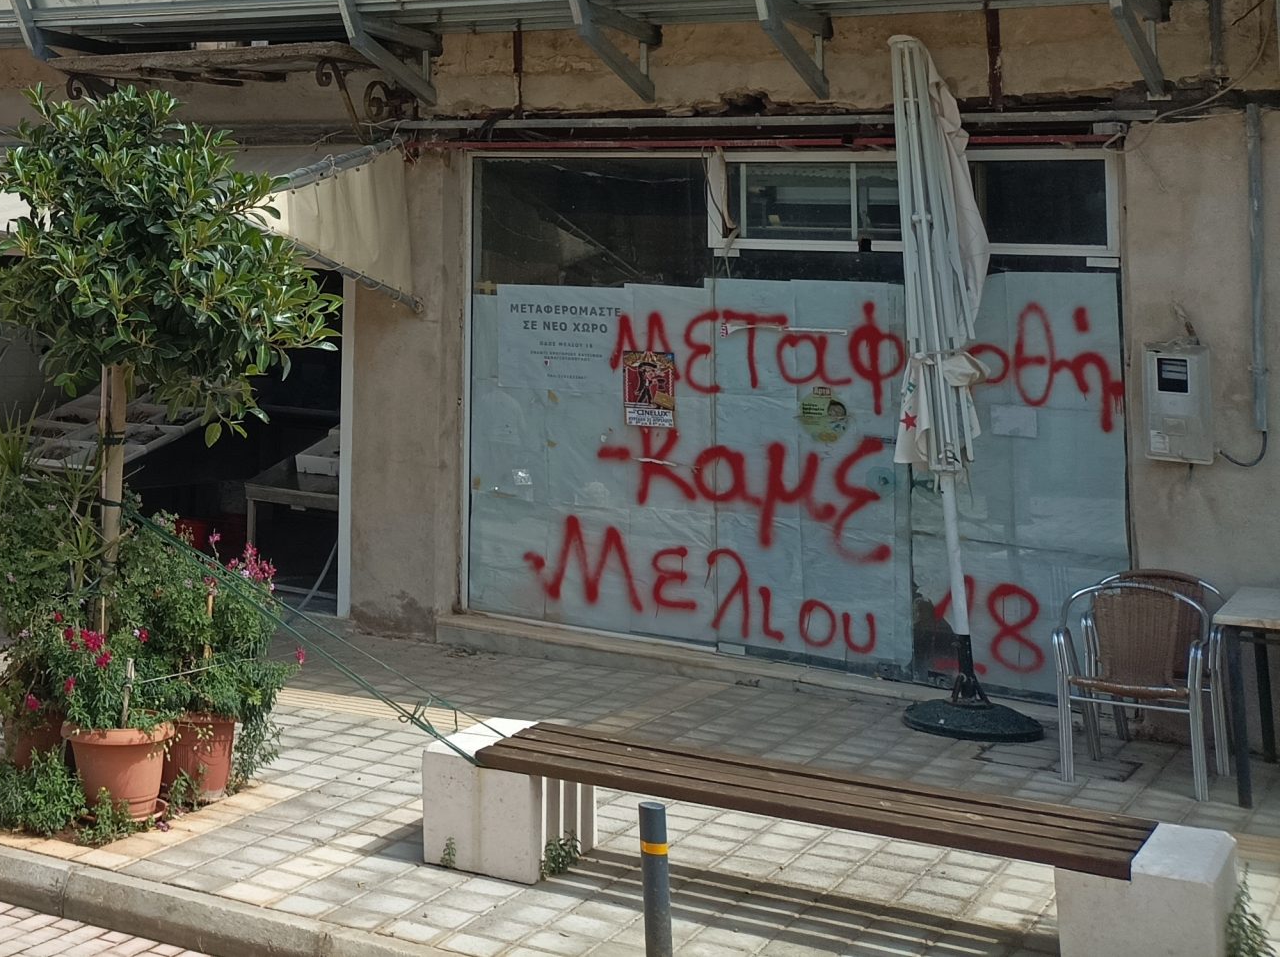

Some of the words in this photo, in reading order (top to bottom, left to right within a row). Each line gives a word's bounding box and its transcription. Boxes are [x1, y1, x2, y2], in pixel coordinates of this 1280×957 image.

[510, 303, 621, 317] ΜΕΤΑΦΕΡΟΜΑΣΤΕ
[523, 320, 537, 330] ΣΕ
[543, 321, 568, 332] ΝΕΟ
[573, 322, 608, 333] ΧΩΡΟ
